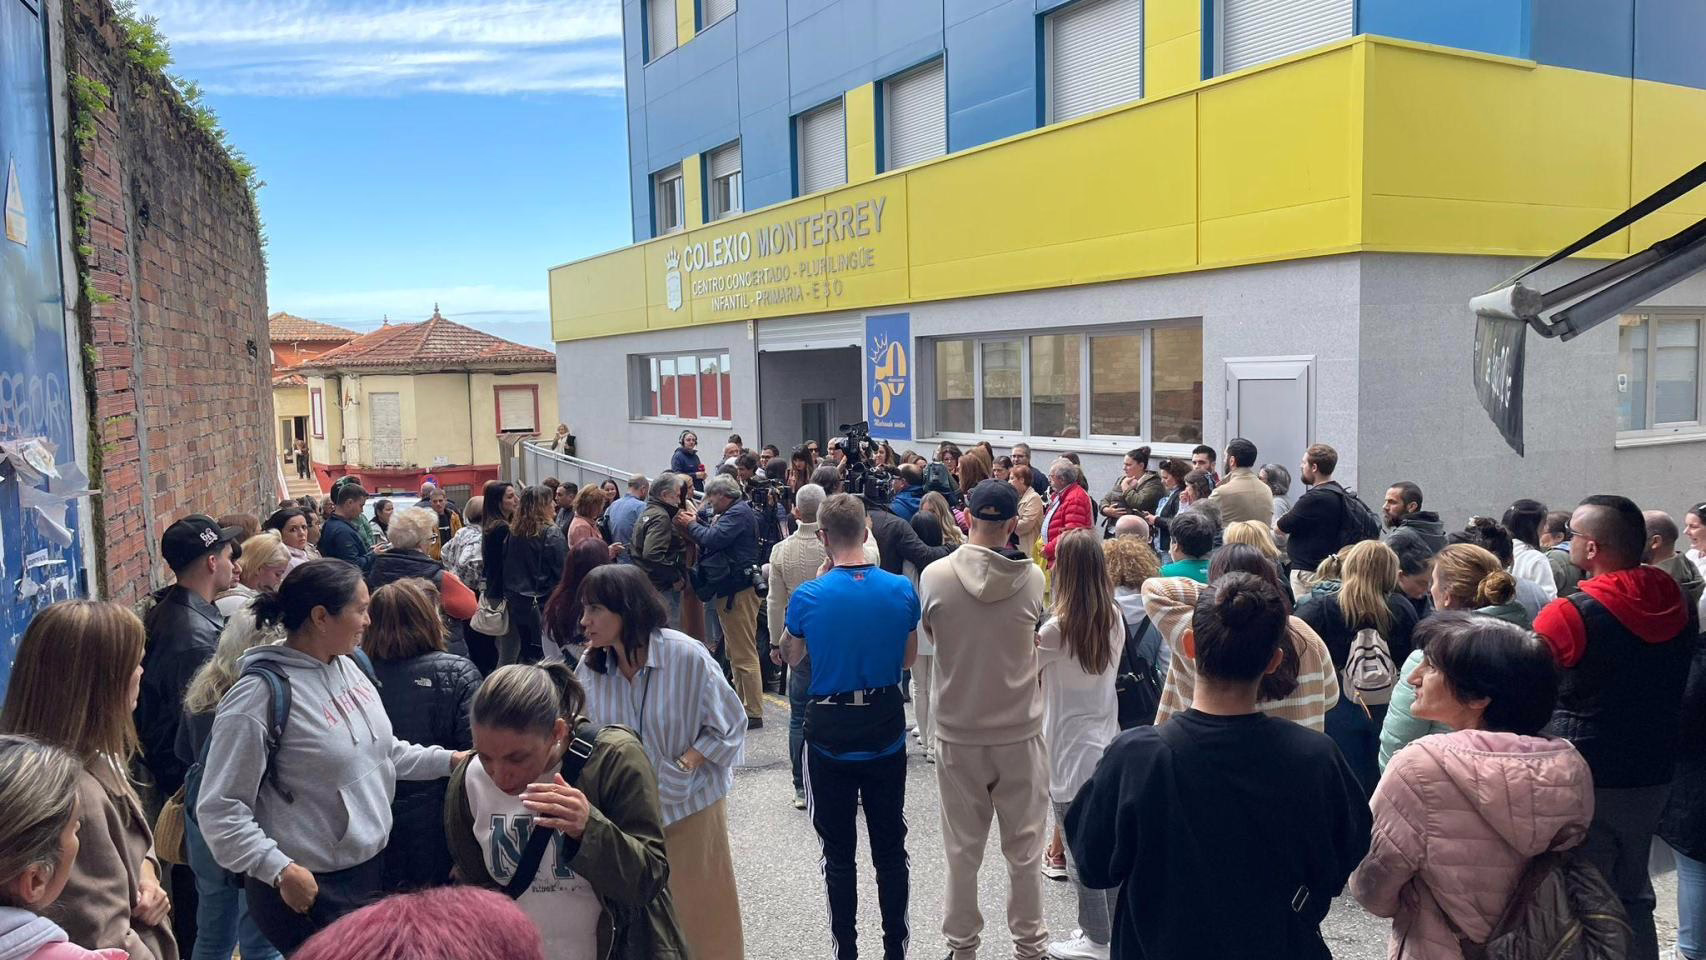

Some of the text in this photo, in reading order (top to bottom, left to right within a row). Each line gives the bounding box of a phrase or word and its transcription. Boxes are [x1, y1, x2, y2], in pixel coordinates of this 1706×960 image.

[684, 196, 887, 273] COLEXIO MONTERREY
[692, 277, 726, 296] CENTRO
[727, 268, 790, 290] CONCERTADO
[800, 247, 876, 278] PLURILINGÜE
[711, 295, 749, 312] INFANTIL
[757, 286, 803, 306] PRIMARIA
